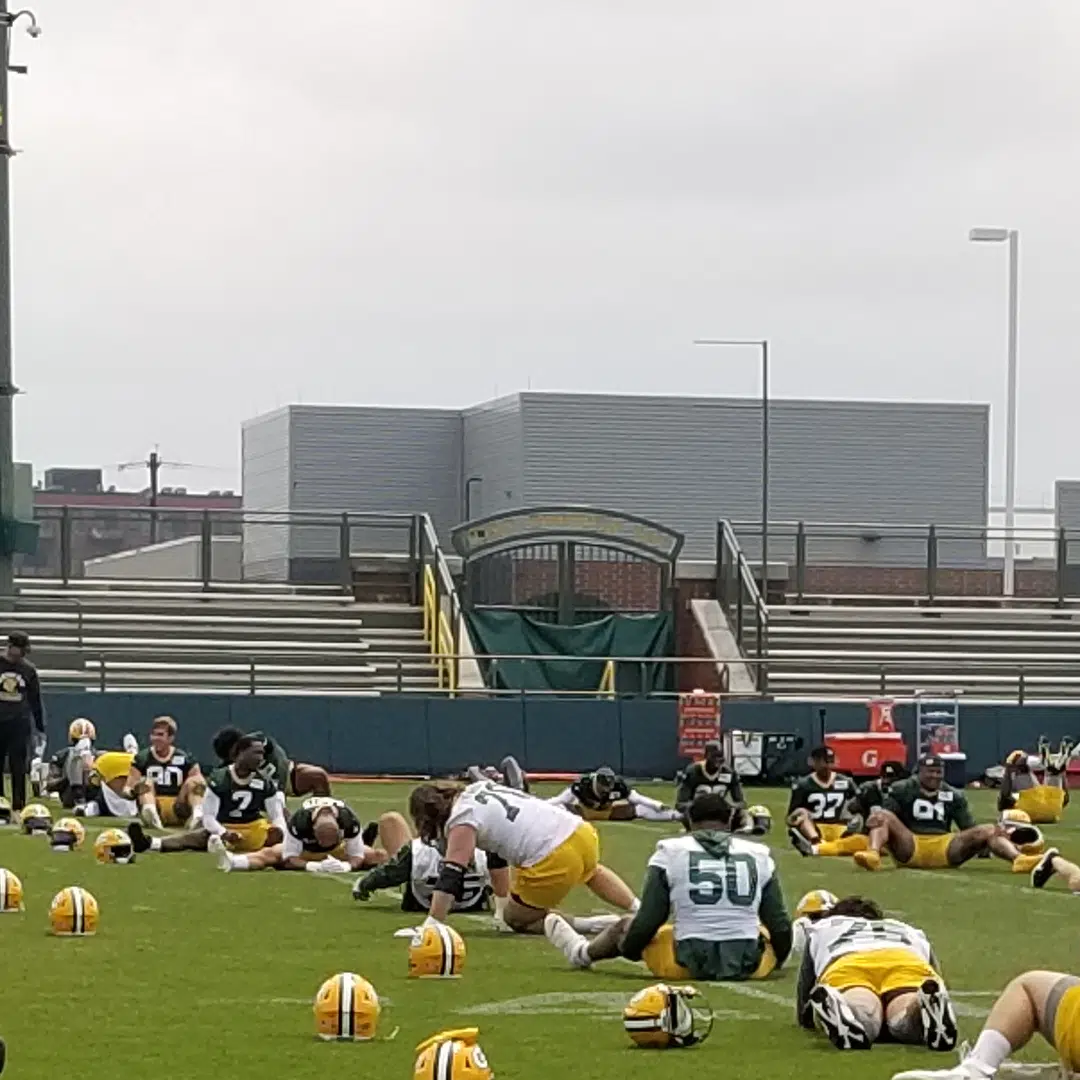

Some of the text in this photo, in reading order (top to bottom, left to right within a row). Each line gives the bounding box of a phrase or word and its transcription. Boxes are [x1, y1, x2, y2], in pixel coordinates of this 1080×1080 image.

[862, 750, 878, 768] G
[229, 790, 253, 817] 7
[807, 793, 844, 819] 37
[688, 851, 758, 906] 50
